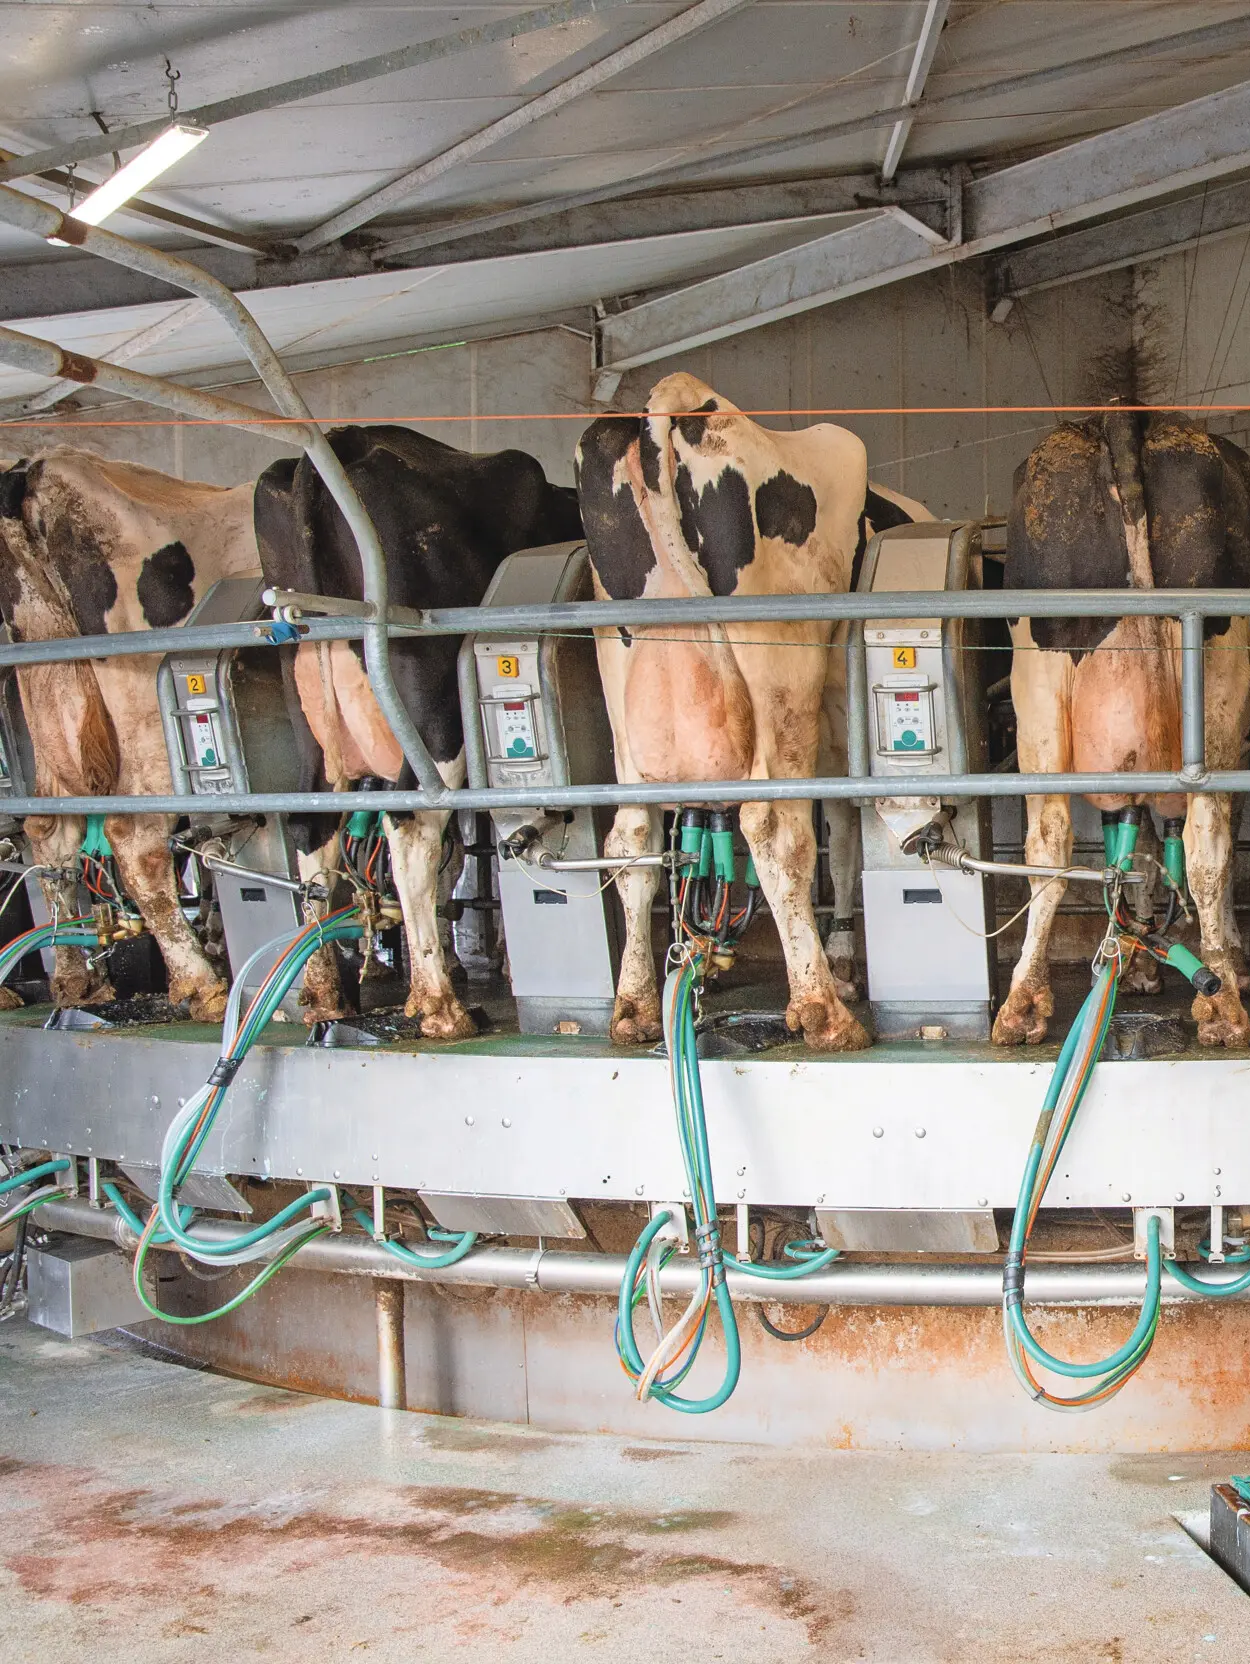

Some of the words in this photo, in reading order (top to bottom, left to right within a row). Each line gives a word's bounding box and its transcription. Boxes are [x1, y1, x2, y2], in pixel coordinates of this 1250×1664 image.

[897, 651, 907, 665] 4
[502, 660, 512, 675] 3
[190, 678, 199, 691] 2
